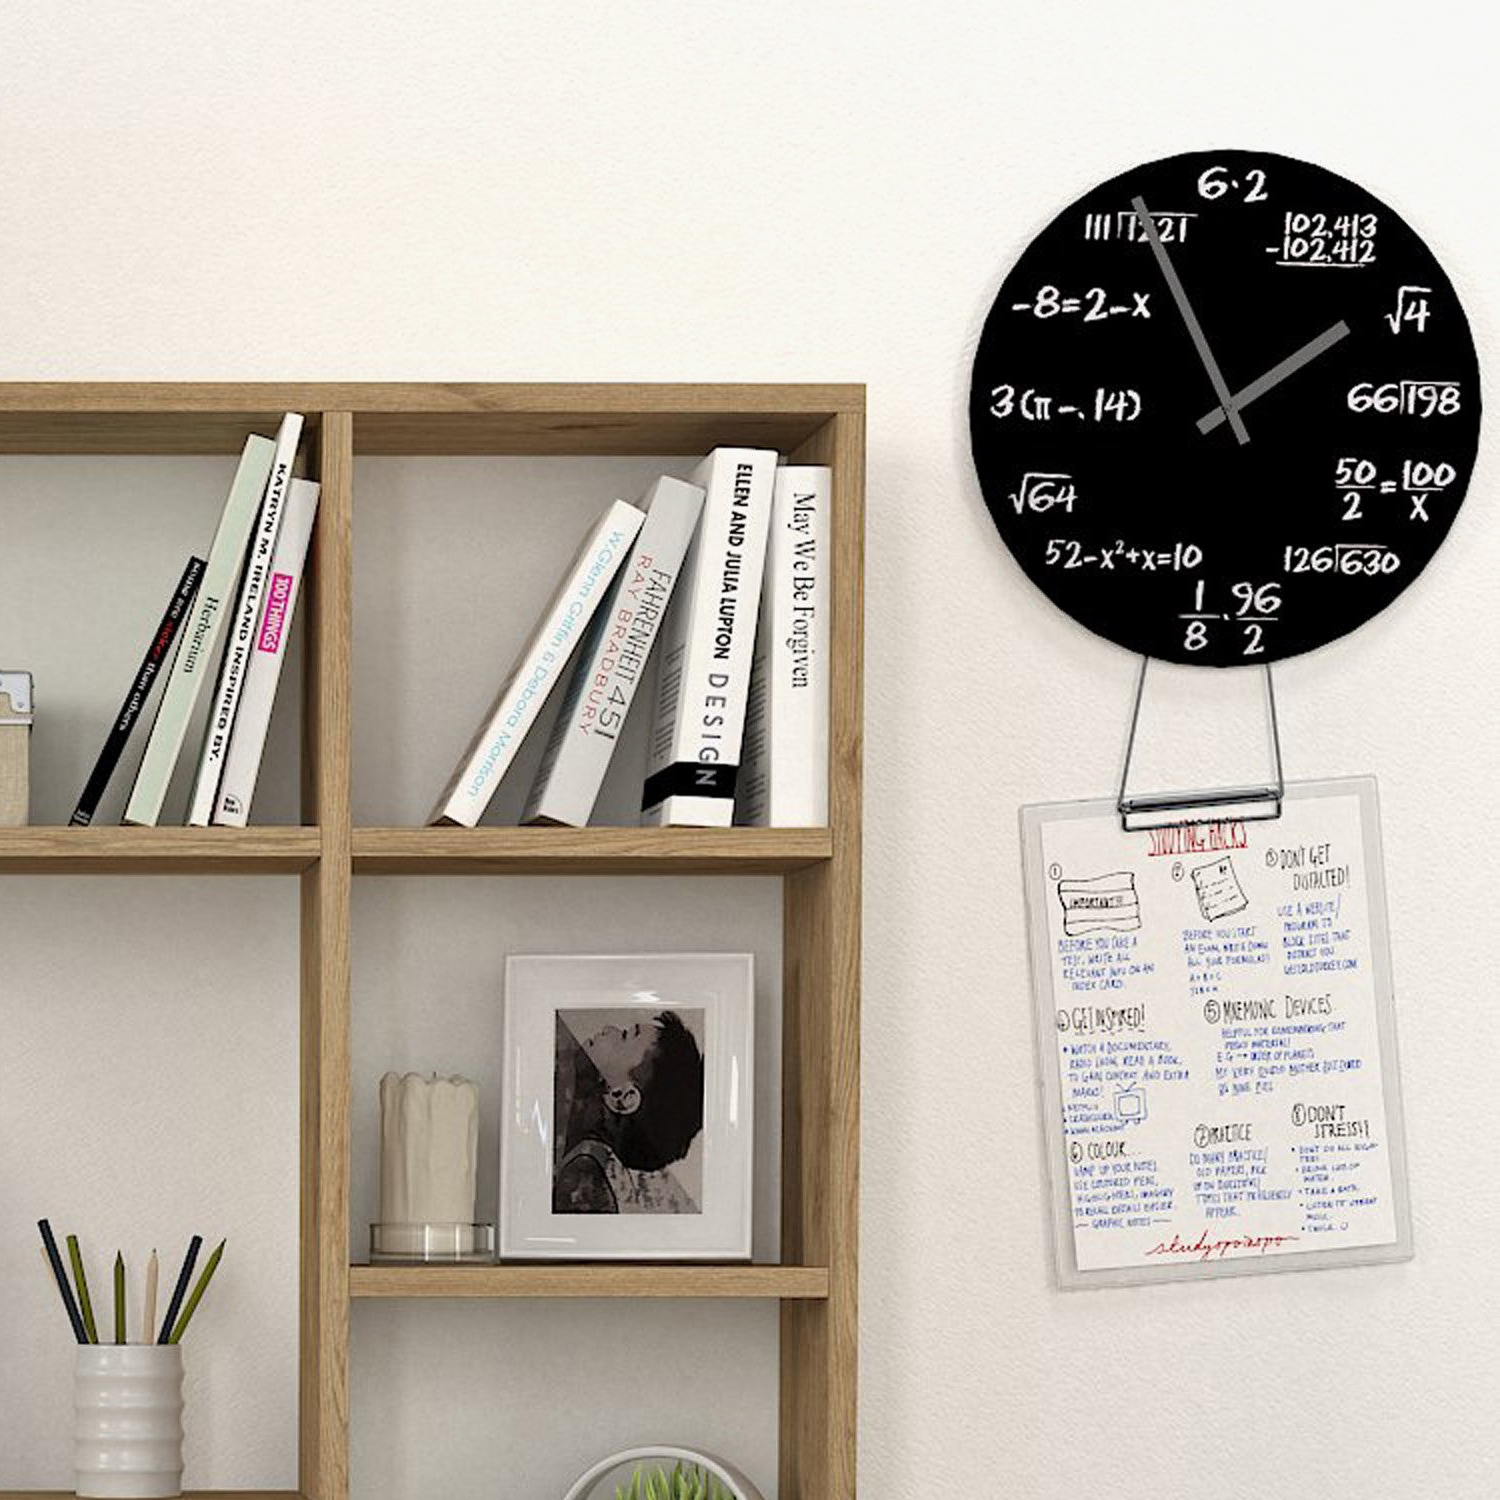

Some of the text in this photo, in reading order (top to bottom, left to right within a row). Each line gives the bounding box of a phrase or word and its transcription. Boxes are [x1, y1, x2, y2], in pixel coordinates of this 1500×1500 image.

[262, 462, 287, 533] KATRYN
[713, 463, 753, 659] ELLEN AND JULIA LUPTON
[786, 493, 816, 688] May We Be Forgiven
[181, 595, 219, 676] Herbarium
[237, 564, 263, 641] IRELAND
[258, 574, 292, 650] 100 THINGS
[549, 599, 584, 650] Griffin
[612, 566, 672, 686] FAHRENHEIT
[576, 553, 653, 737] RAY BRADBURY
[215, 646, 244, 730] INSPIRED
[466, 728, 513, 799] Morrison
[696, 673, 729, 786] DESIGN
